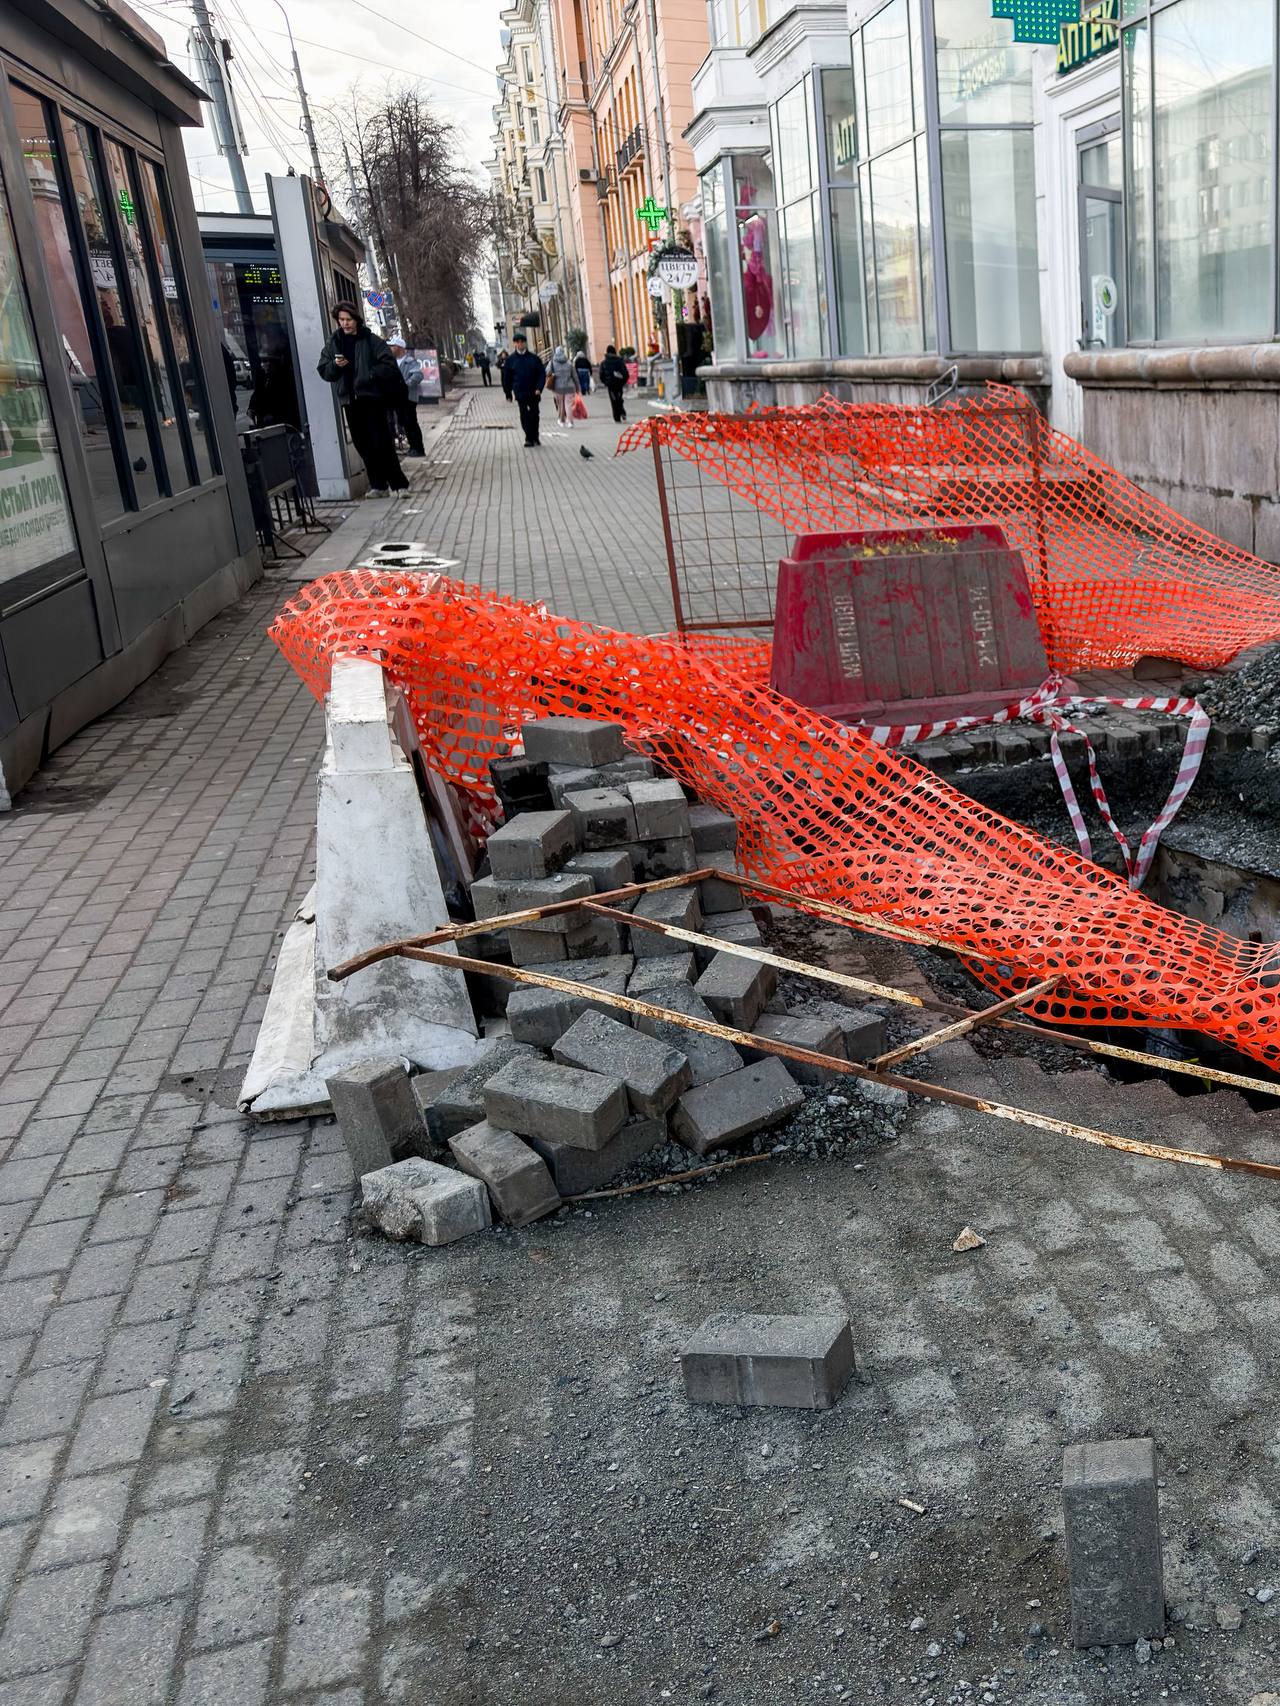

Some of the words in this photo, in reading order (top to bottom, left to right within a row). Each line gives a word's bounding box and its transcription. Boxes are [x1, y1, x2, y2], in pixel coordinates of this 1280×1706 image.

[1056, 0, 1119, 73] АПТЕК
[661, 263, 696, 271] ЦВЕТЫ
[667, 272, 692, 284] 24/7
[0, 475, 33, 520] СТЫЙ
[31, 474, 63, 508] ГОРОД
